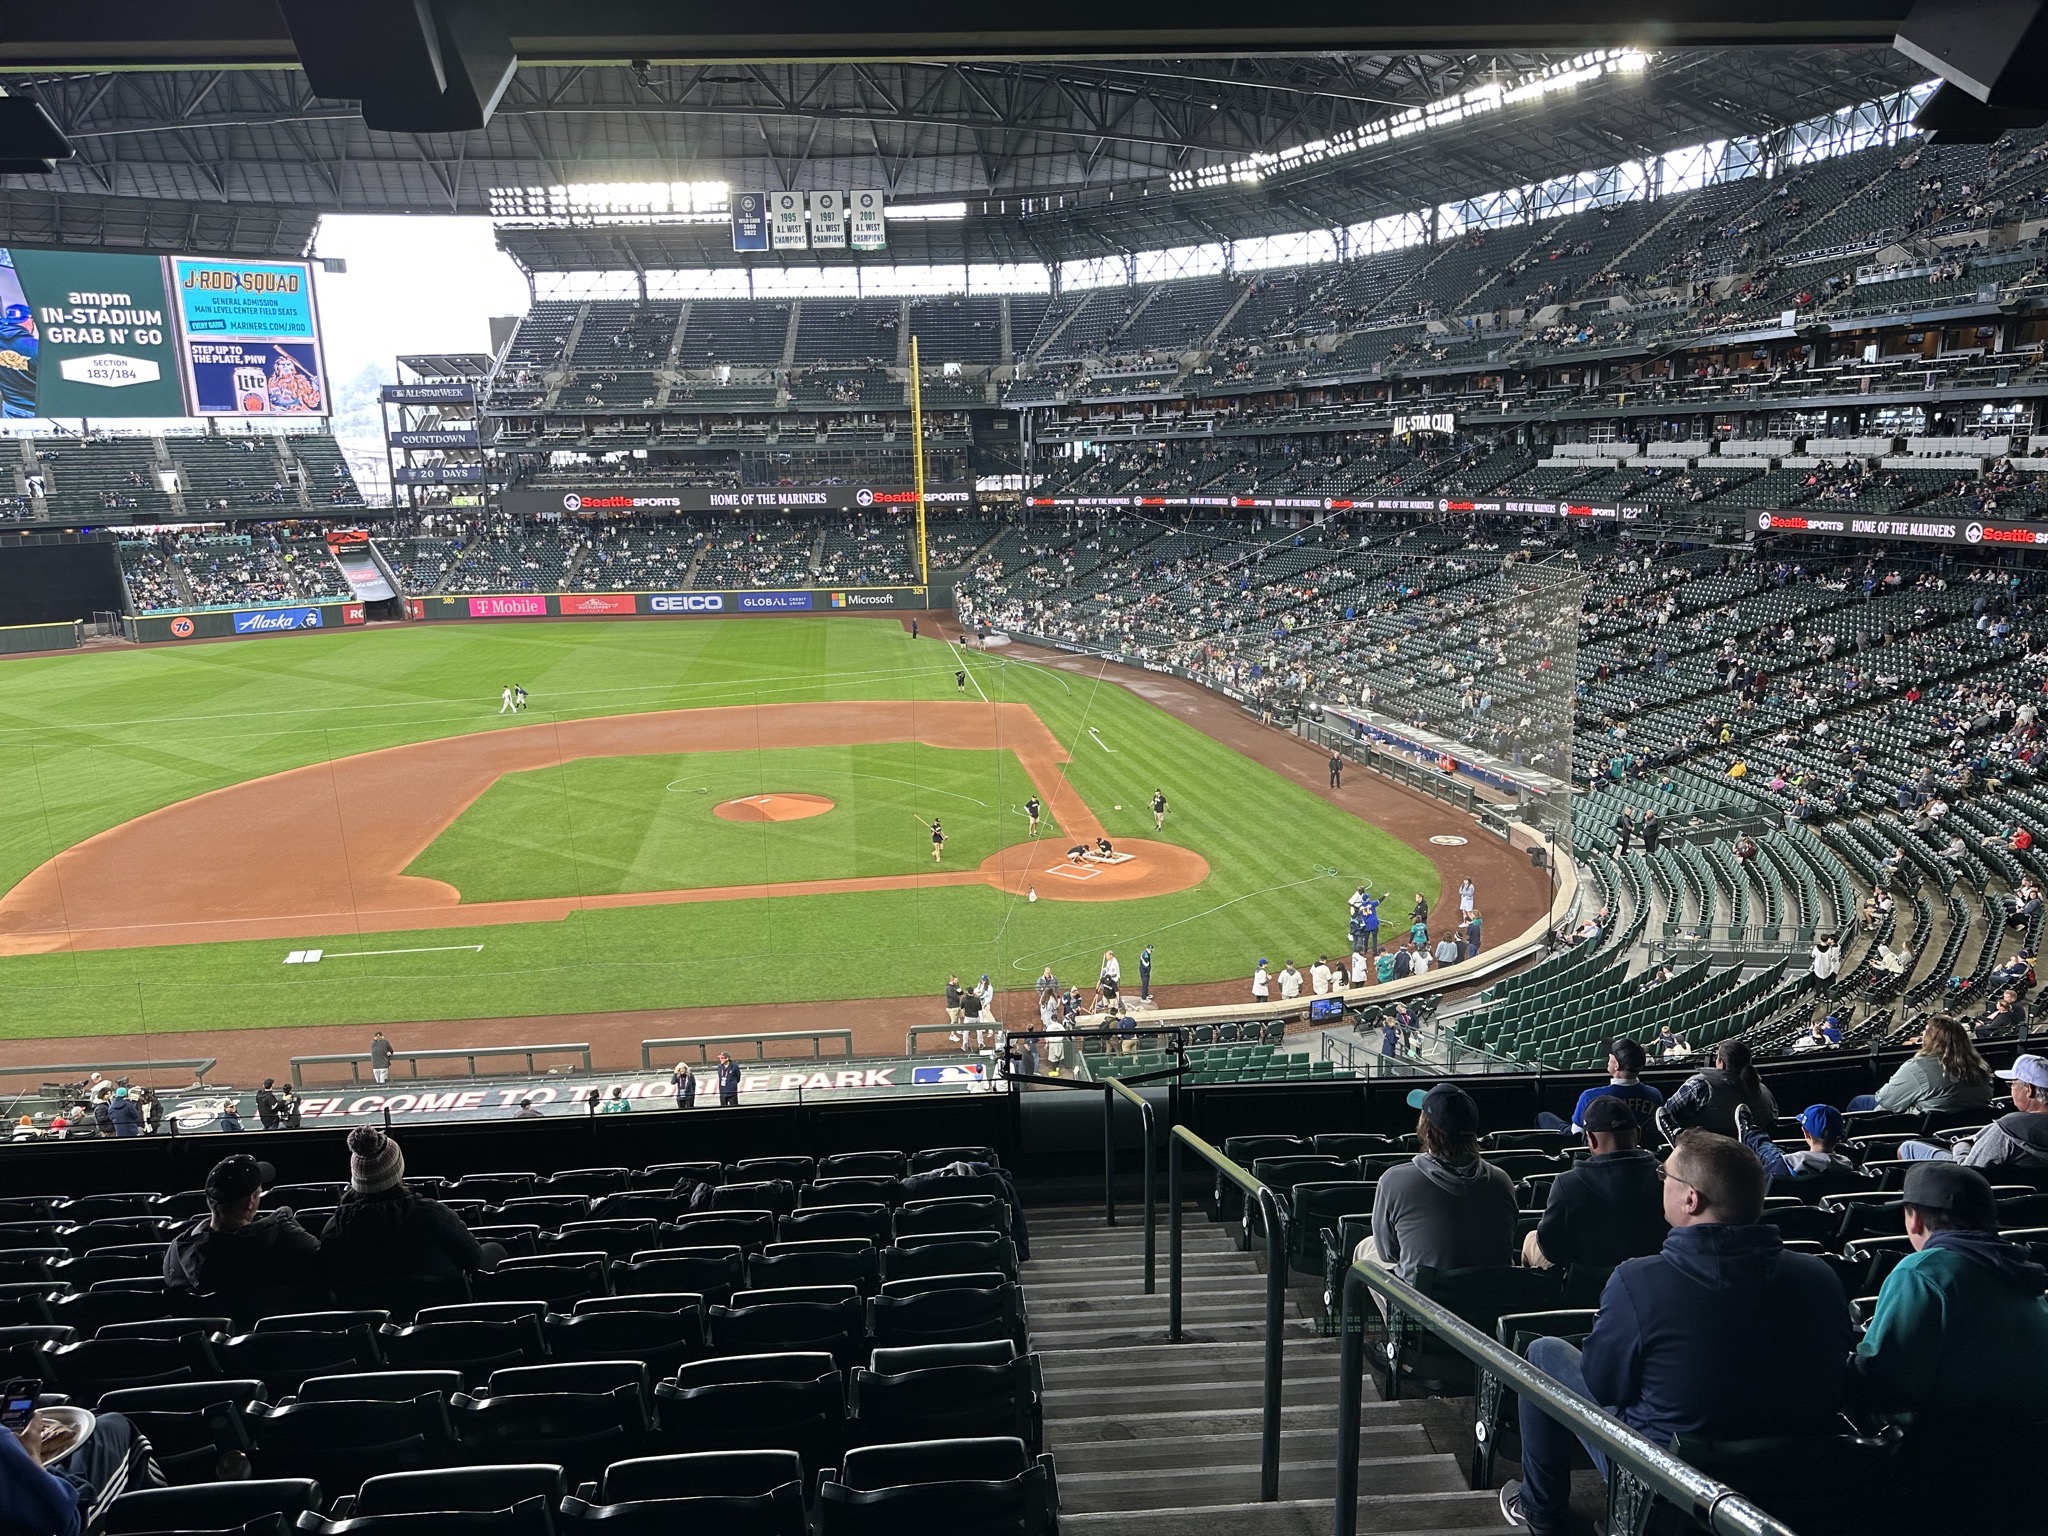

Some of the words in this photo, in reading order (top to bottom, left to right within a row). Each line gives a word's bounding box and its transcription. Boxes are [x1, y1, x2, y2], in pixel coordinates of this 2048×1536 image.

[781, 212, 797, 222] 1995
[820, 212, 835, 222] 1997
[860, 211, 876, 221] 2001
[777, 225, 786, 233] A.L.
[787, 225, 802, 233] WEST
[816, 224, 825, 232] A.L.
[825, 224, 840, 232] WEST
[855, 224, 865, 232] A.L.
[865, 223, 880, 232] WEST
[774, 236, 805, 244] CHAMPIONS
[813, 235, 844, 244] CHAMPIONS
[853, 234, 884, 242] CHAMPIONS
[243, 272, 299, 294] SQUAD
[68, 291, 132, 309] ampm
[212, 297, 241, 306] GENERAL
[242, 298, 279, 307] ADMISSION
[213, 306, 233, 314] LEVEL
[233, 307, 259, 315] CENTER
[259, 308, 277, 316] FIELD
[277, 308, 298, 316] SEATS
[41, 307, 163, 326] IN-STADIUM
[230, 321, 306, 332] MARINERS.COM/JROD
[48, 327, 106, 344] GRAB
[134, 329, 163, 345] GO
[191, 345, 215, 355] STEP
[215, 345, 230, 355] UP
[230, 346, 243, 355] TO
[93, 359, 128, 367] SECTION
[193, 355, 213, 364] THE
[213, 355, 243, 365] PLATE,
[243, 355, 267, 365] PNW
[87, 368, 137, 380] 183/184
[237, 374, 265, 392] Lite
[439, 388, 463, 397] WEEK
[1432, 413, 1454, 434] CLUB
[402, 434, 466, 444] COUNTDOWN
[442, 469, 468, 477] DAYS
[710, 494, 739, 505] HOME
[741, 494, 754, 505] OF
[756, 493, 776, 504] THE
[778, 493, 827, 504] MARINERS
[1852, 520, 1876, 533] HOME
[1877, 521, 1890, 534] OF
[1891, 522, 1909, 535] THE
[1909, 523, 1956, 538] MARINERS
[651, 596, 723, 611] GEICO
[743, 597, 787, 606] GLOBAL
[848, 594, 894, 605] Microsoft
[491, 600, 538, 614] Mobile
[239, 613, 294, 630] Alaska
[175, 623, 190, 632] 76
[1143, 661, 1163, 672] KeyBank
[498, 1087, 557, 1110] TO
[776, 1067, 898, 1092] PARK
